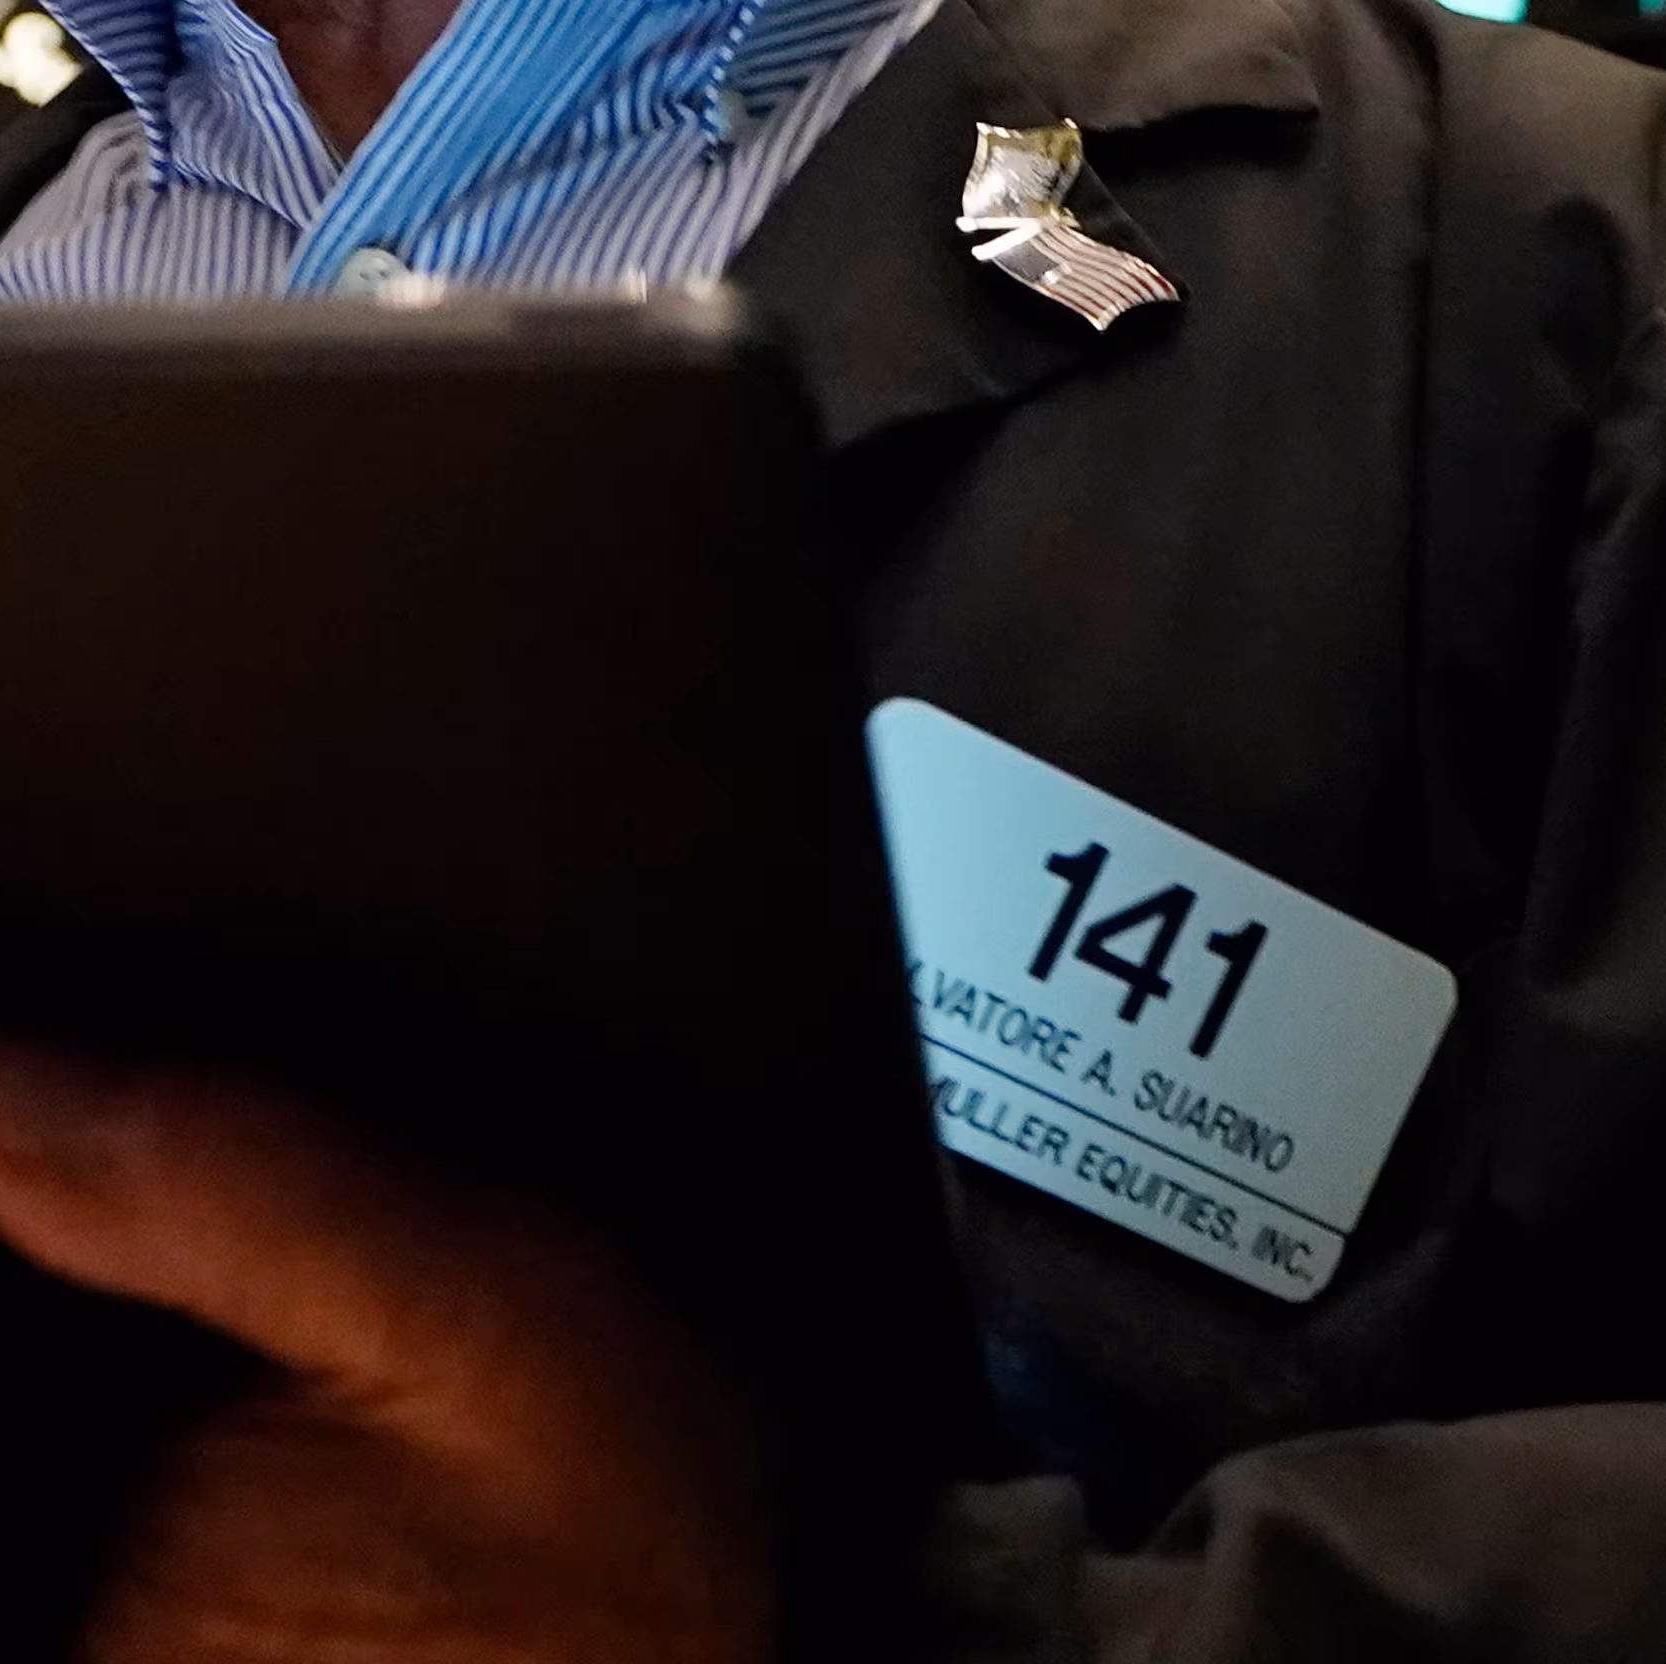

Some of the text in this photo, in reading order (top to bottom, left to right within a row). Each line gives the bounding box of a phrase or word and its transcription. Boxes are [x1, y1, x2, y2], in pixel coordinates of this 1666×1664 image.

[1026, 841, 1270, 1061] 141
[1080, 1047, 1118, 1097] A.
[1133, 1069, 1295, 1174] SUARINO
[1251, 1224, 1315, 1284] INC.
